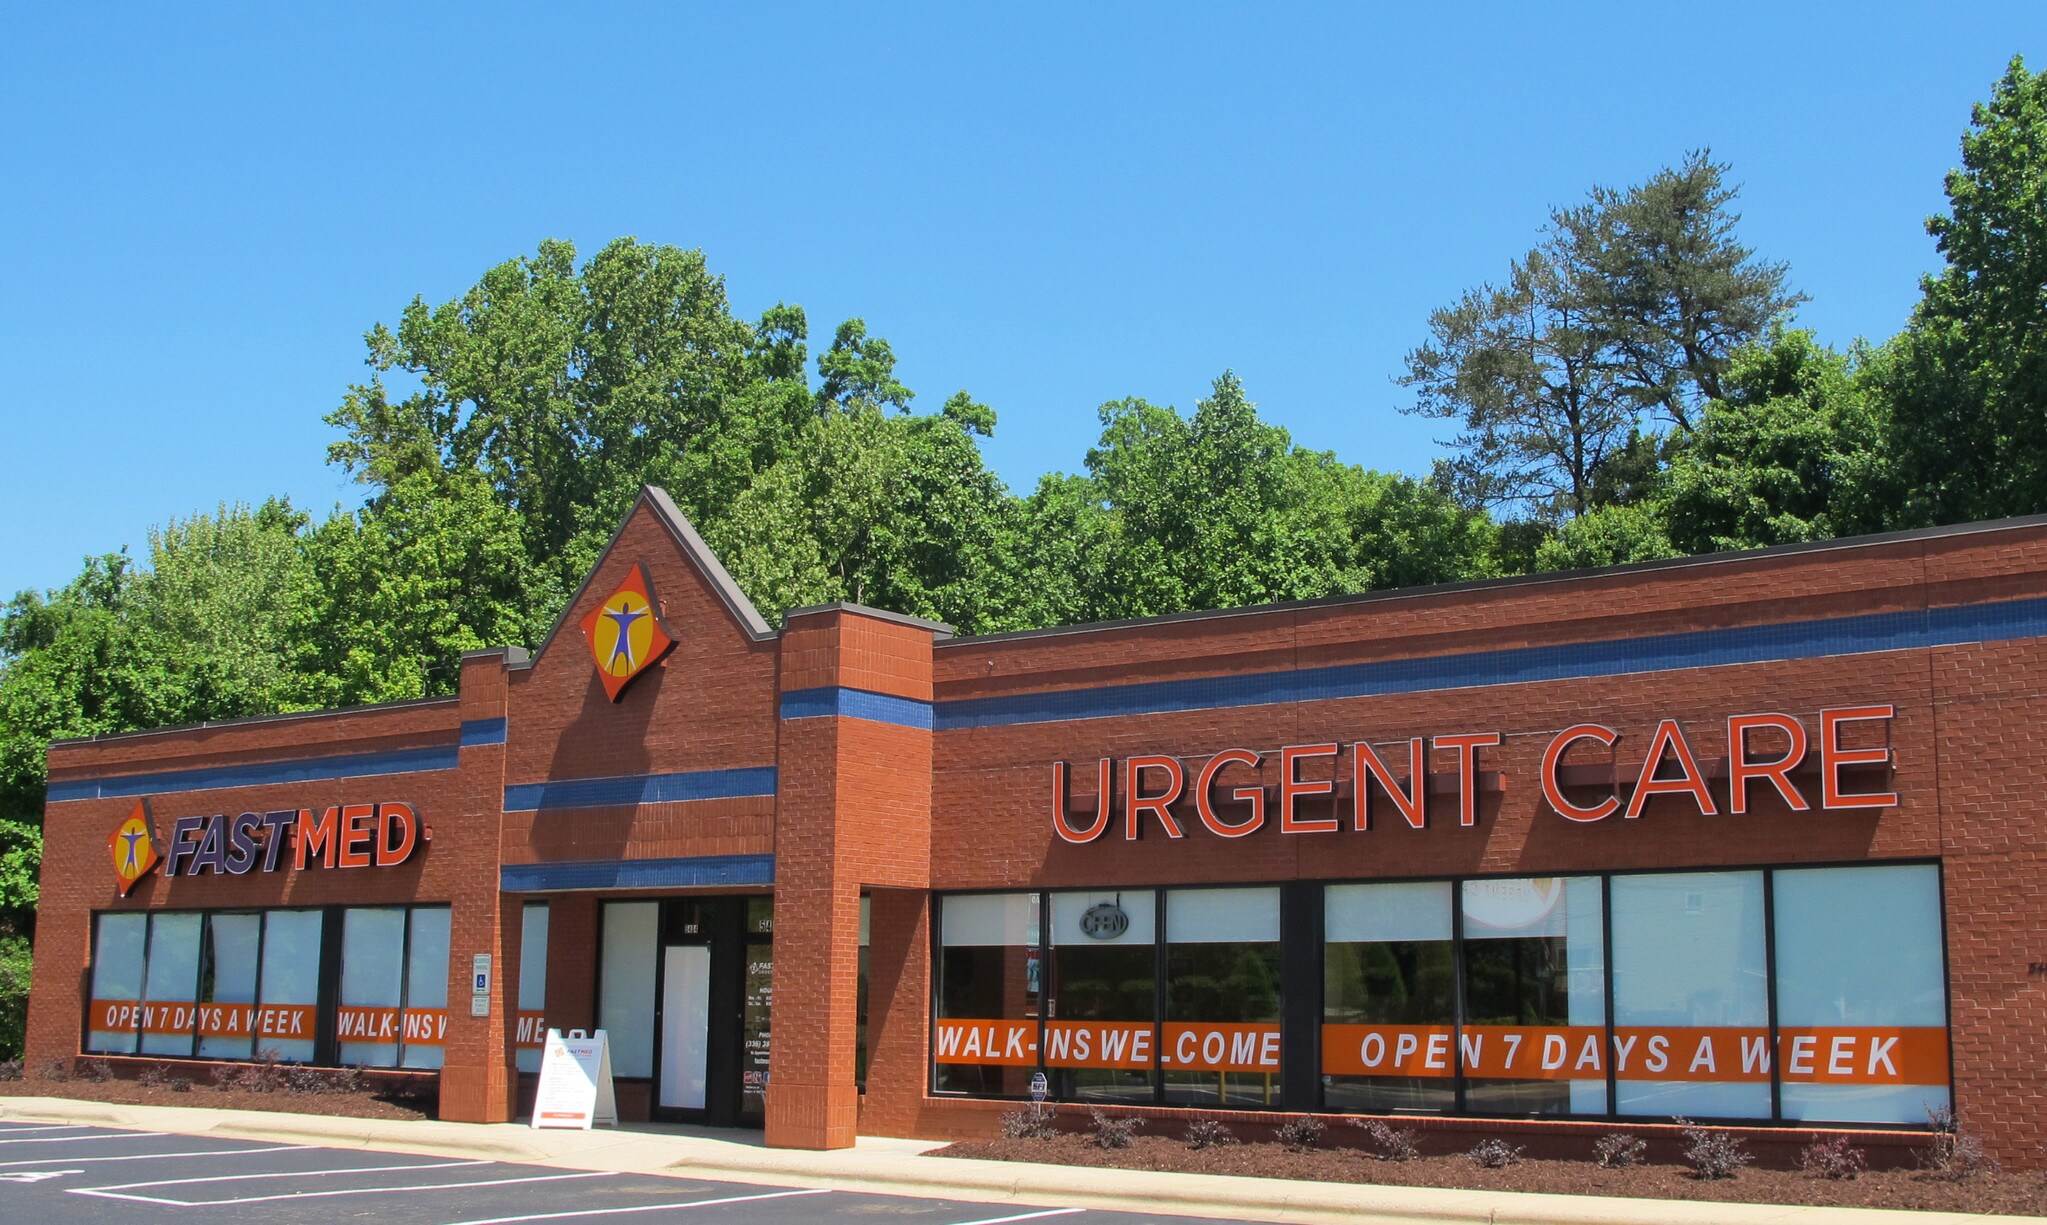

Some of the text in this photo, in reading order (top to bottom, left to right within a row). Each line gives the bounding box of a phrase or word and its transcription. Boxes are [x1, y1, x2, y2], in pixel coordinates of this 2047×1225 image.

[1052, 703, 1900, 844] URGENT CARE
[165, 801, 418, 877] FASTMED
[106, 1005, 304, 1034] OPEN 7 DAYS A WEEK
[338, 1011, 433, 1039] WALK-INS
[938, 1026, 1281, 1065] WALK-INS WECOME
[1360, 1032, 1900, 1076] OPEN 7 DAYS A WEEK
